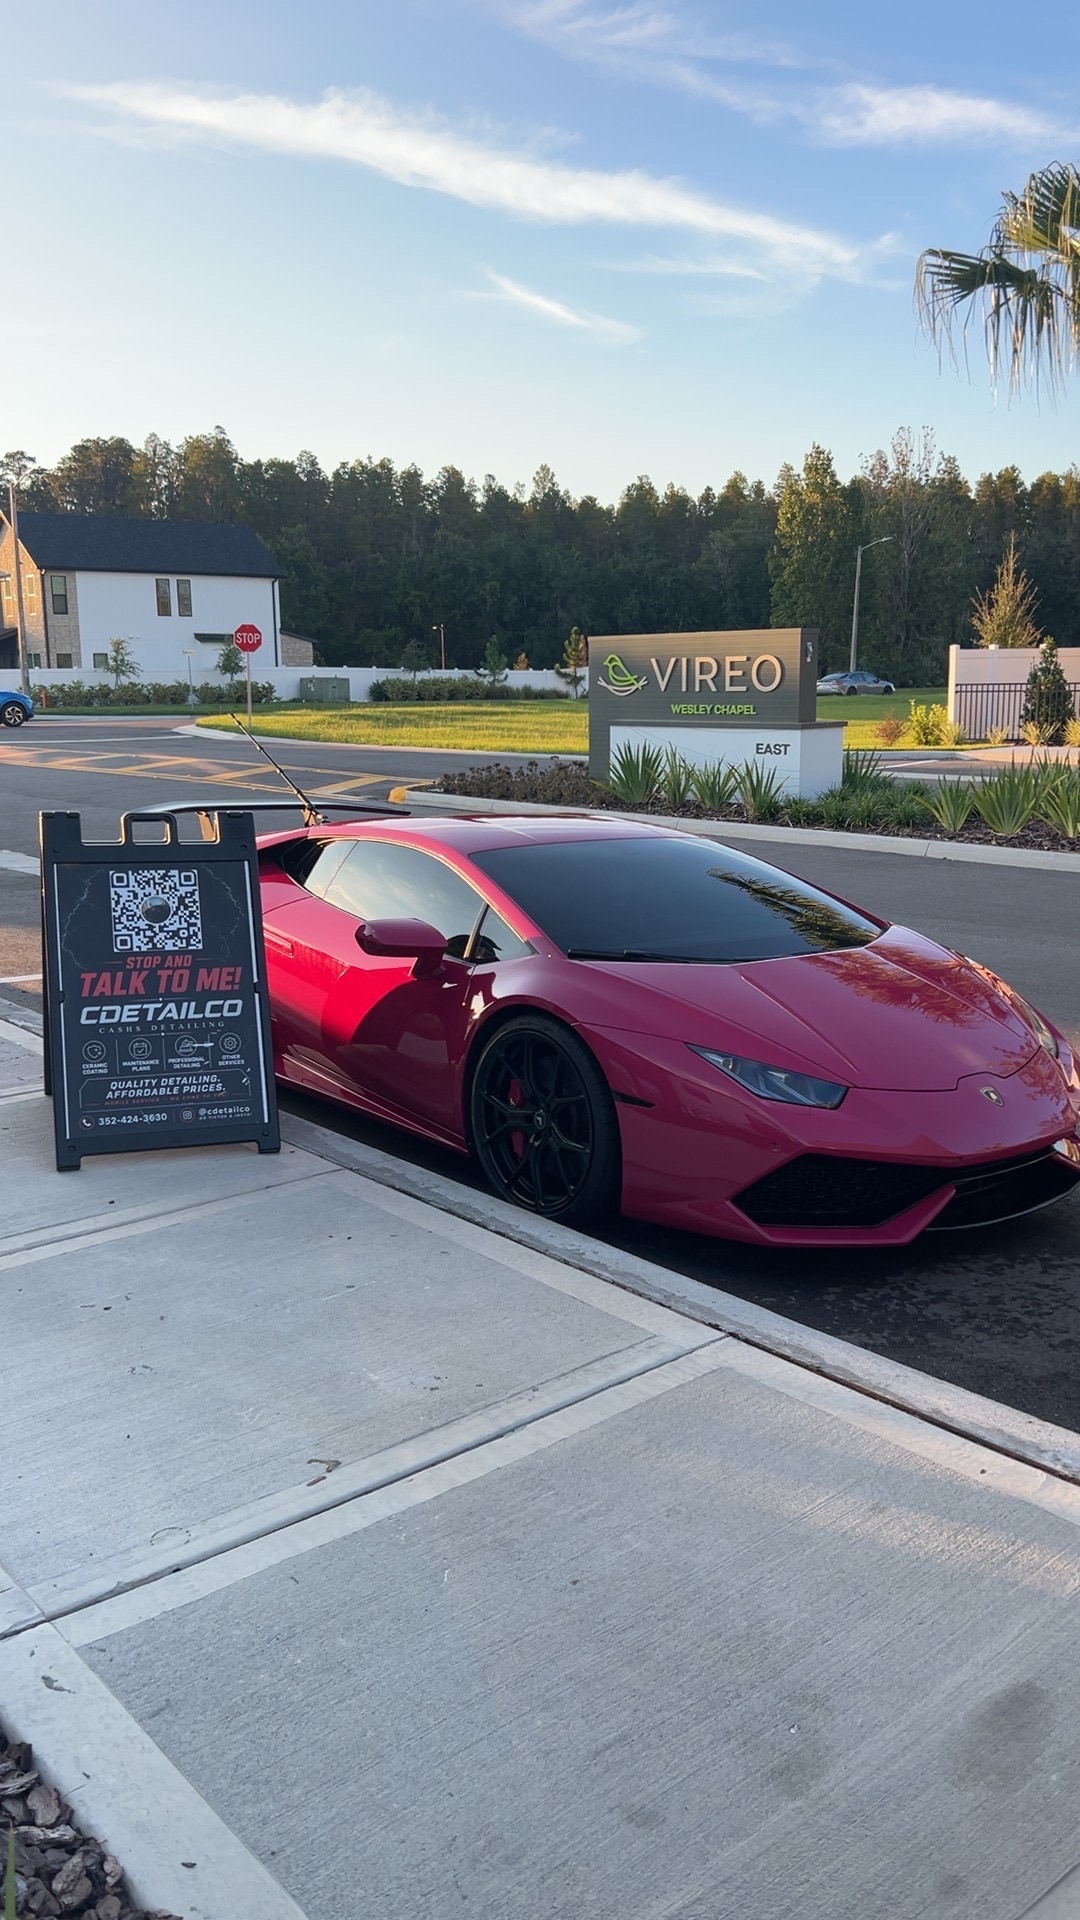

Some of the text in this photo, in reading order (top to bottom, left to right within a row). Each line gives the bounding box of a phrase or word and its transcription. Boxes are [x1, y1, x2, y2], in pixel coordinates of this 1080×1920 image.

[236, 632, 260, 644] STOP
[650, 654, 782, 692] VIREO
[671, 704, 756, 714] WESLEY CHAPEL
[756, 744, 790, 755] EAST
[126, 954, 192, 969] STOP AND
[80, 966, 242, 998] TALK TO ME!
[80, 999, 243, 1024] CDETAILCO
[98, 1020, 226, 1034] CASHS DETAILING
[110, 1075, 220, 1090] QUALITY DETAILING.
[106, 1083, 226, 1100] AFFORDABLE PRICES.
[198, 1106, 250, 1116] @cdetailco
[98, 1113, 168, 1126] 352-424-3630
